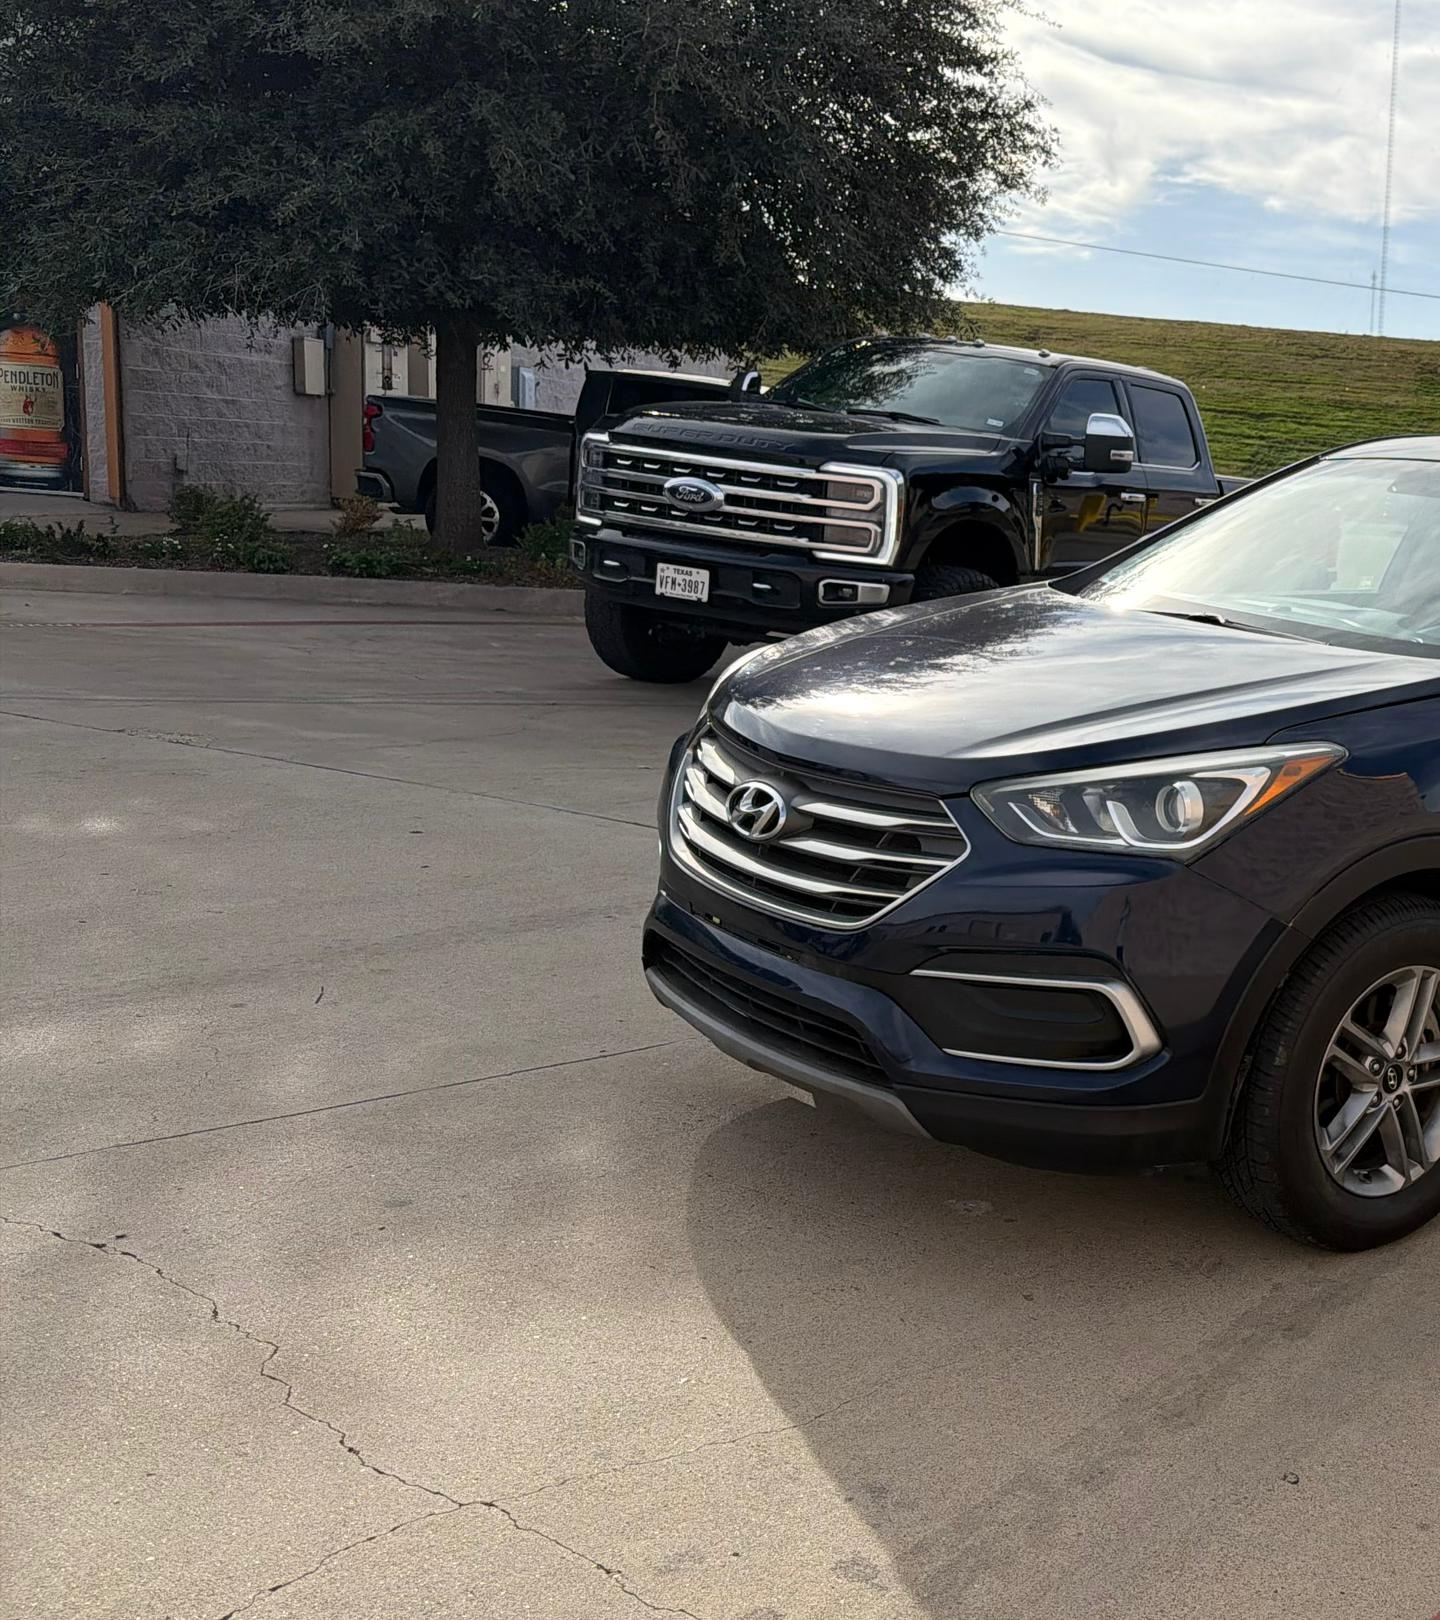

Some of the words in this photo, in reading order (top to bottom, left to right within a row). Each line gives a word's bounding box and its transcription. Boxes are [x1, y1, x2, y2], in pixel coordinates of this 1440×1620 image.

[0, 368, 59, 389] PENDLETON
[716, 432, 796, 450] DUTY
[675, 485, 705, 502] Ford
[672, 567, 693, 577] TEXAS
